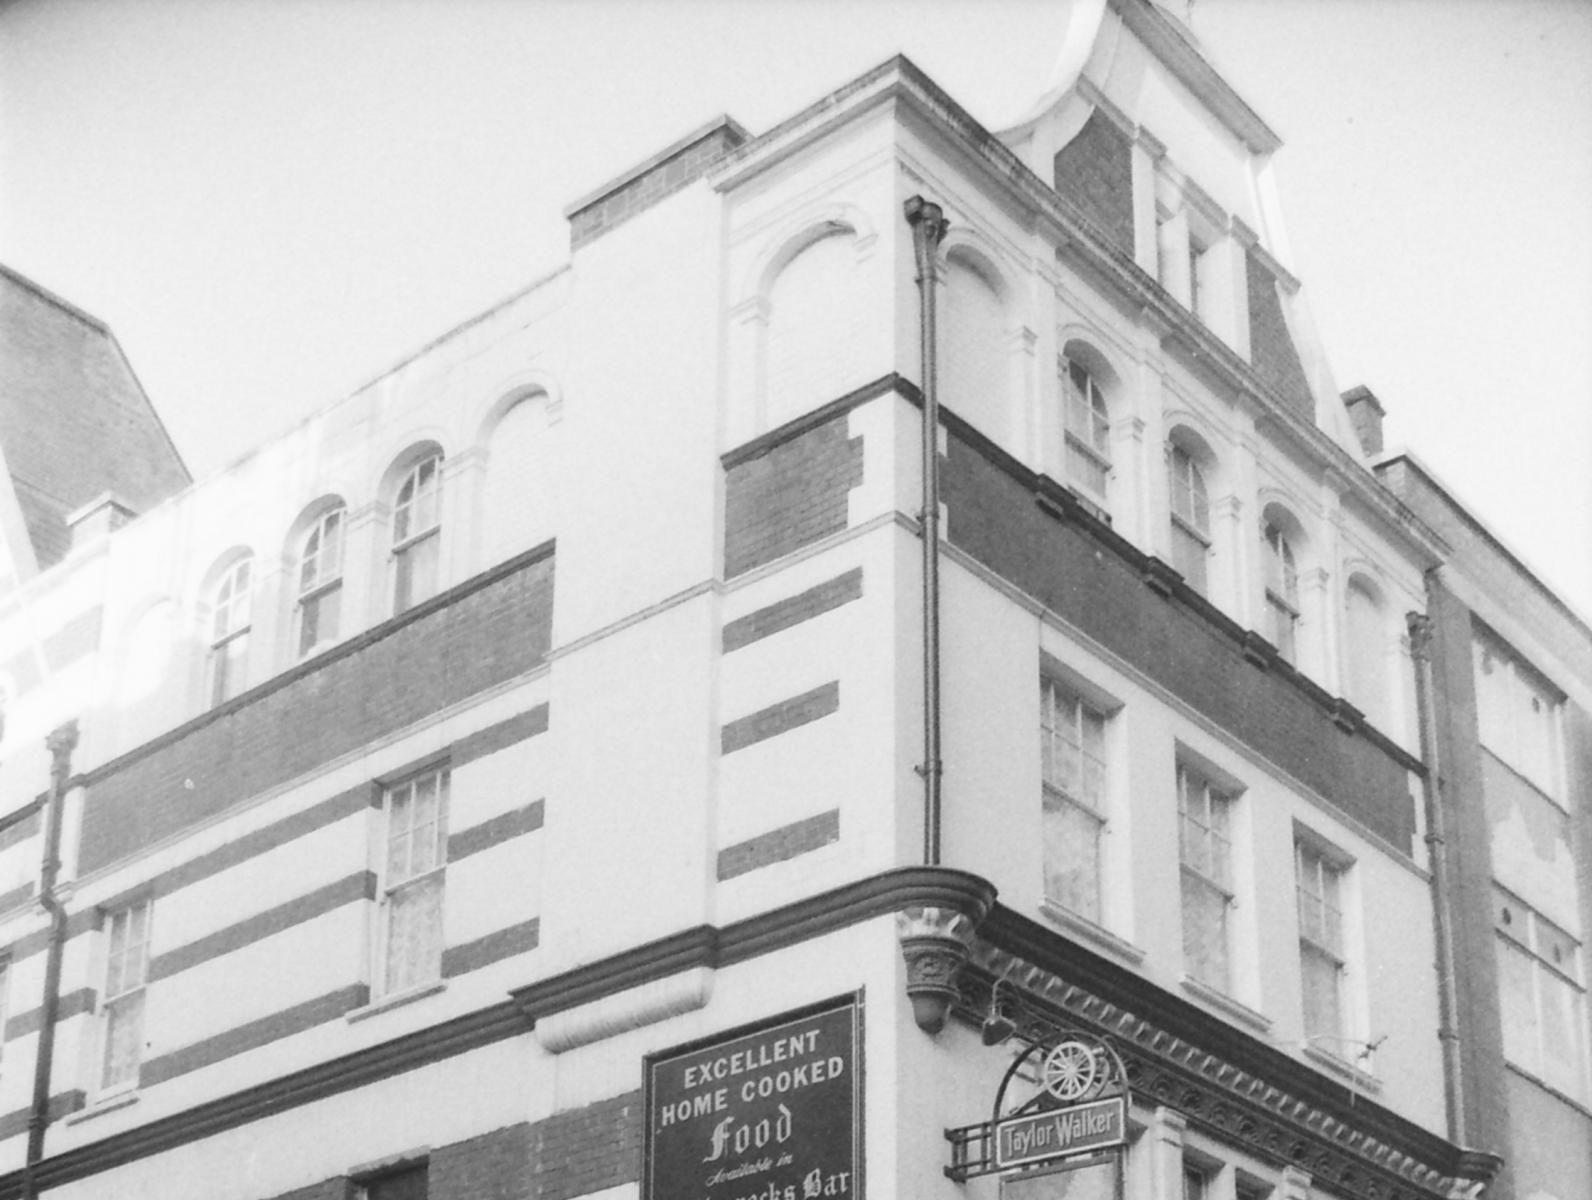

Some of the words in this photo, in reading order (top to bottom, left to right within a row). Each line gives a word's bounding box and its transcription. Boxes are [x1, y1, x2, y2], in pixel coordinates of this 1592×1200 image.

[684, 1029, 820, 1089] EXCELLENT
[661, 1088, 729, 1127] HOME
[741, 1056, 844, 1102] COOKED
[1004, 1122, 1054, 1158] Taylor
[1055, 1109, 1115, 1147] Walker
[705, 1156, 773, 1187] Available
[775, 1152, 793, 1167] in
[803, 1167, 851, 1200] Bar
